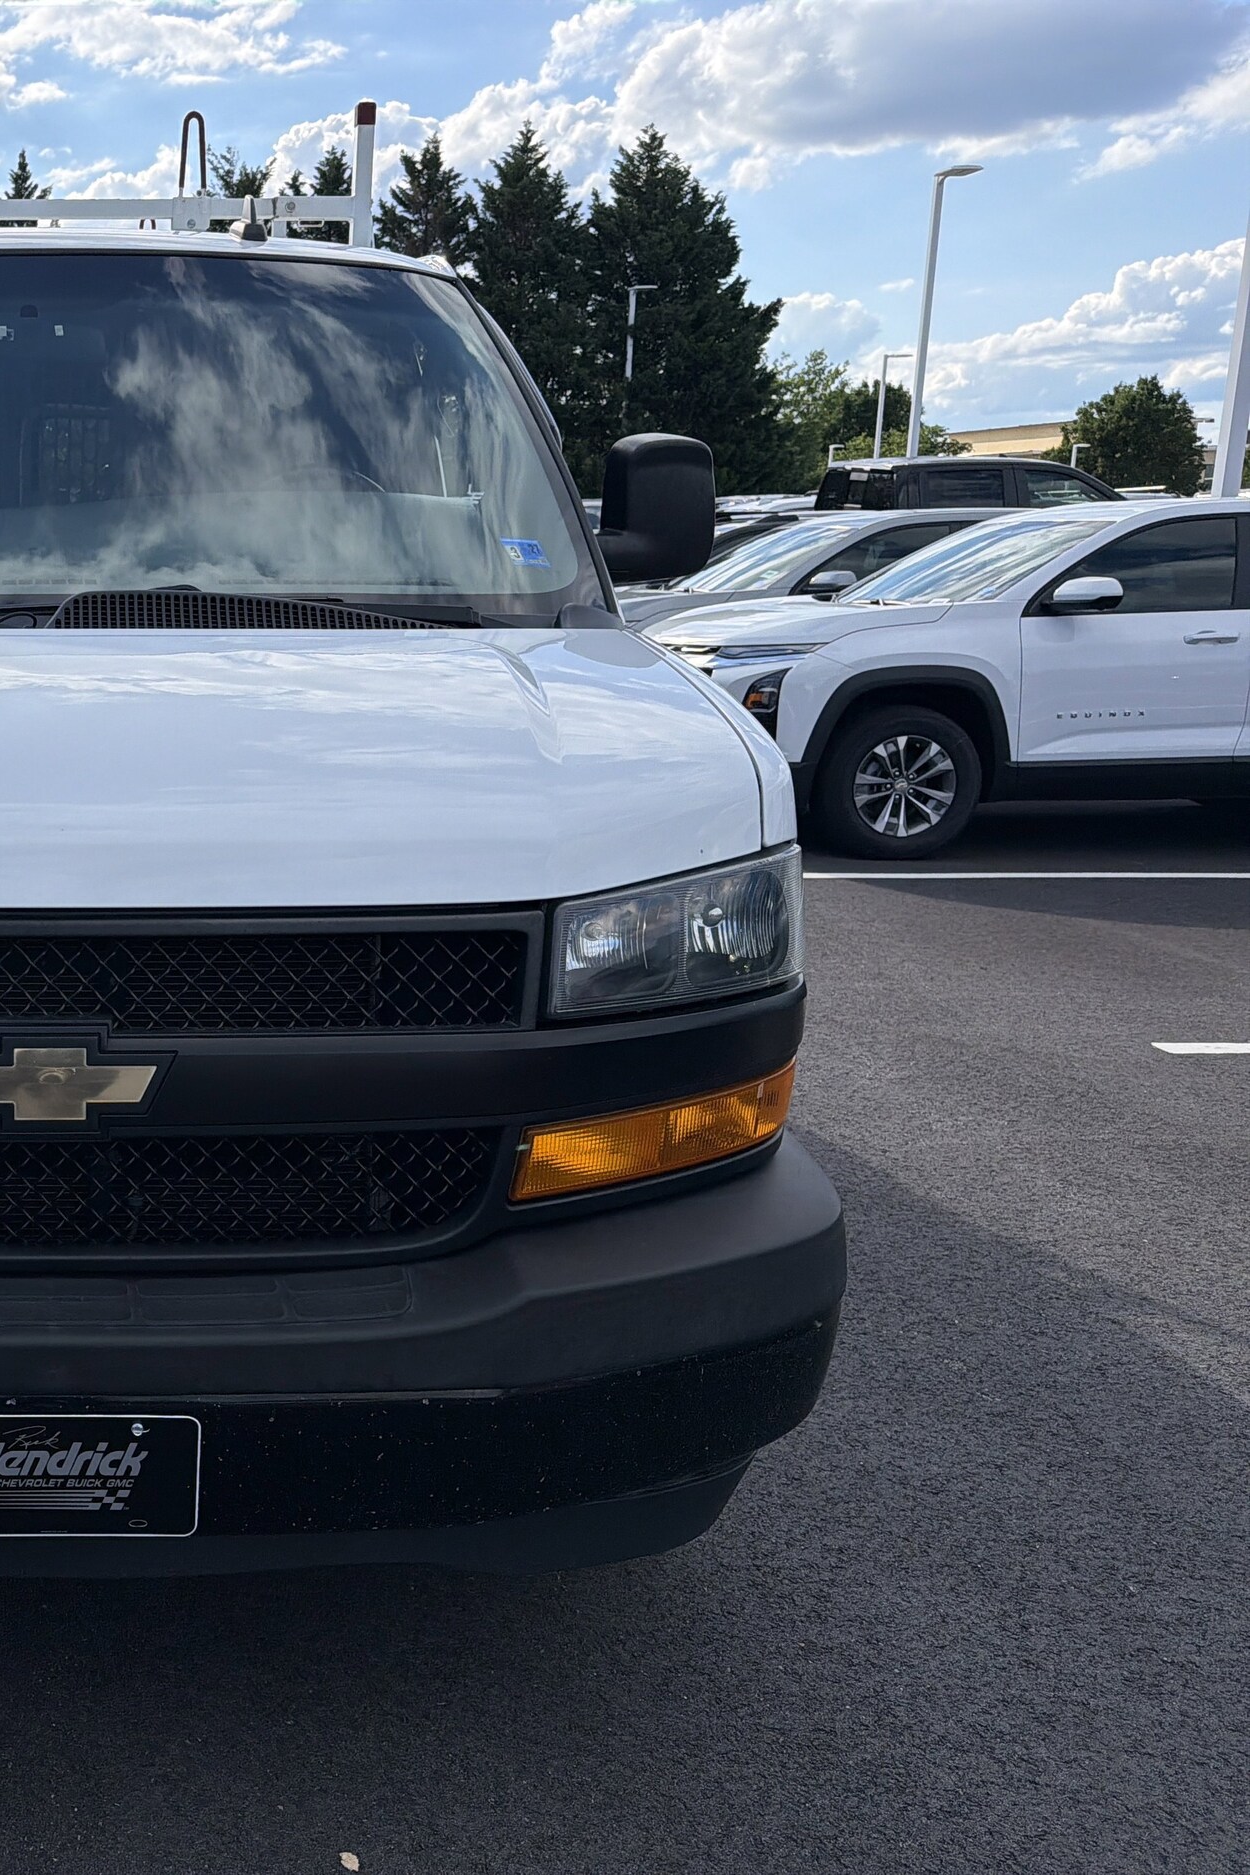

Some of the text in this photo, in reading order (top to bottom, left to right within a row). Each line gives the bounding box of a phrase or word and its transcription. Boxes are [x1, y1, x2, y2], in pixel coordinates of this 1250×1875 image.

[1056, 709, 1145, 719] EQUINOX
[66, 1479, 102, 1488] BUICK
[106, 1479, 134, 1488] GMC
